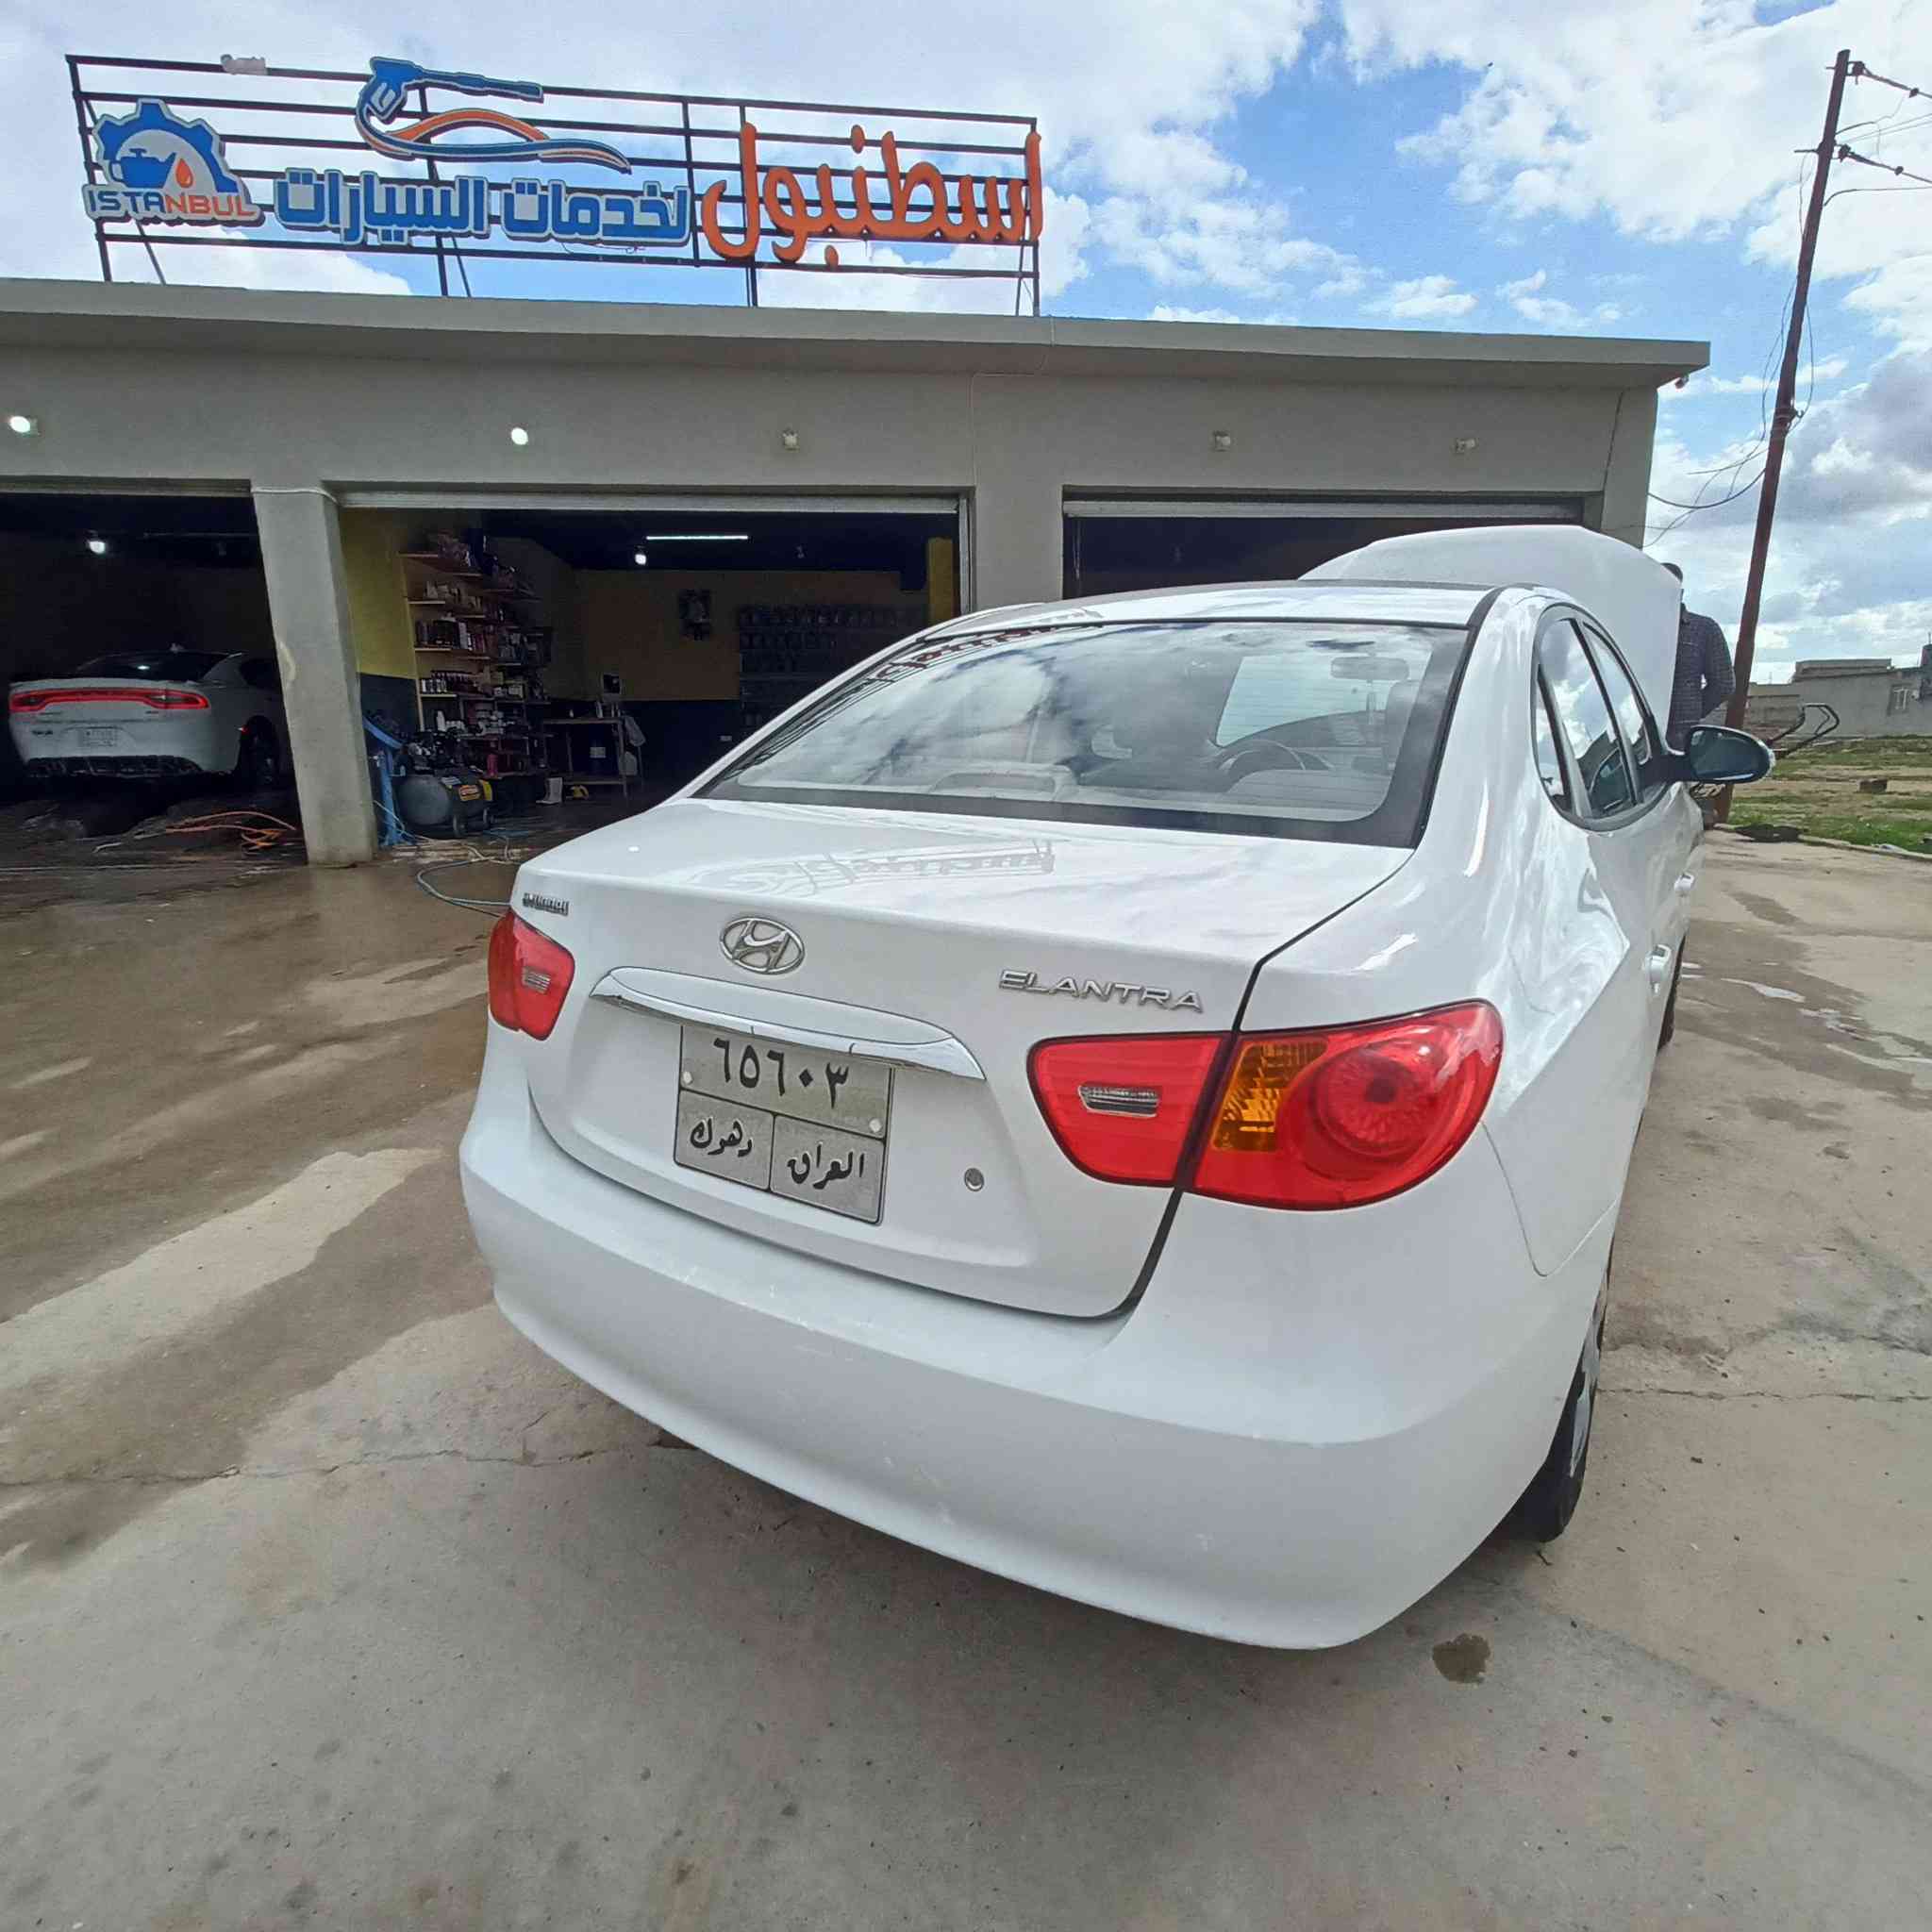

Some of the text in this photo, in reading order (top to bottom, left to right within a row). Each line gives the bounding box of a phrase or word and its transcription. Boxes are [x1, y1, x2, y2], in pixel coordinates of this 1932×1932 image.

[88, 190, 256, 217] ISTANBUL
[277, 122, 1042, 270] اسطنبول لخدمات السيارات
[999, 969, 1204, 1013] ELANTRA
[714, 1037, 849, 1109] ٦٥٦٠٣
[690, 1117, 865, 1190] دهوك العراق
